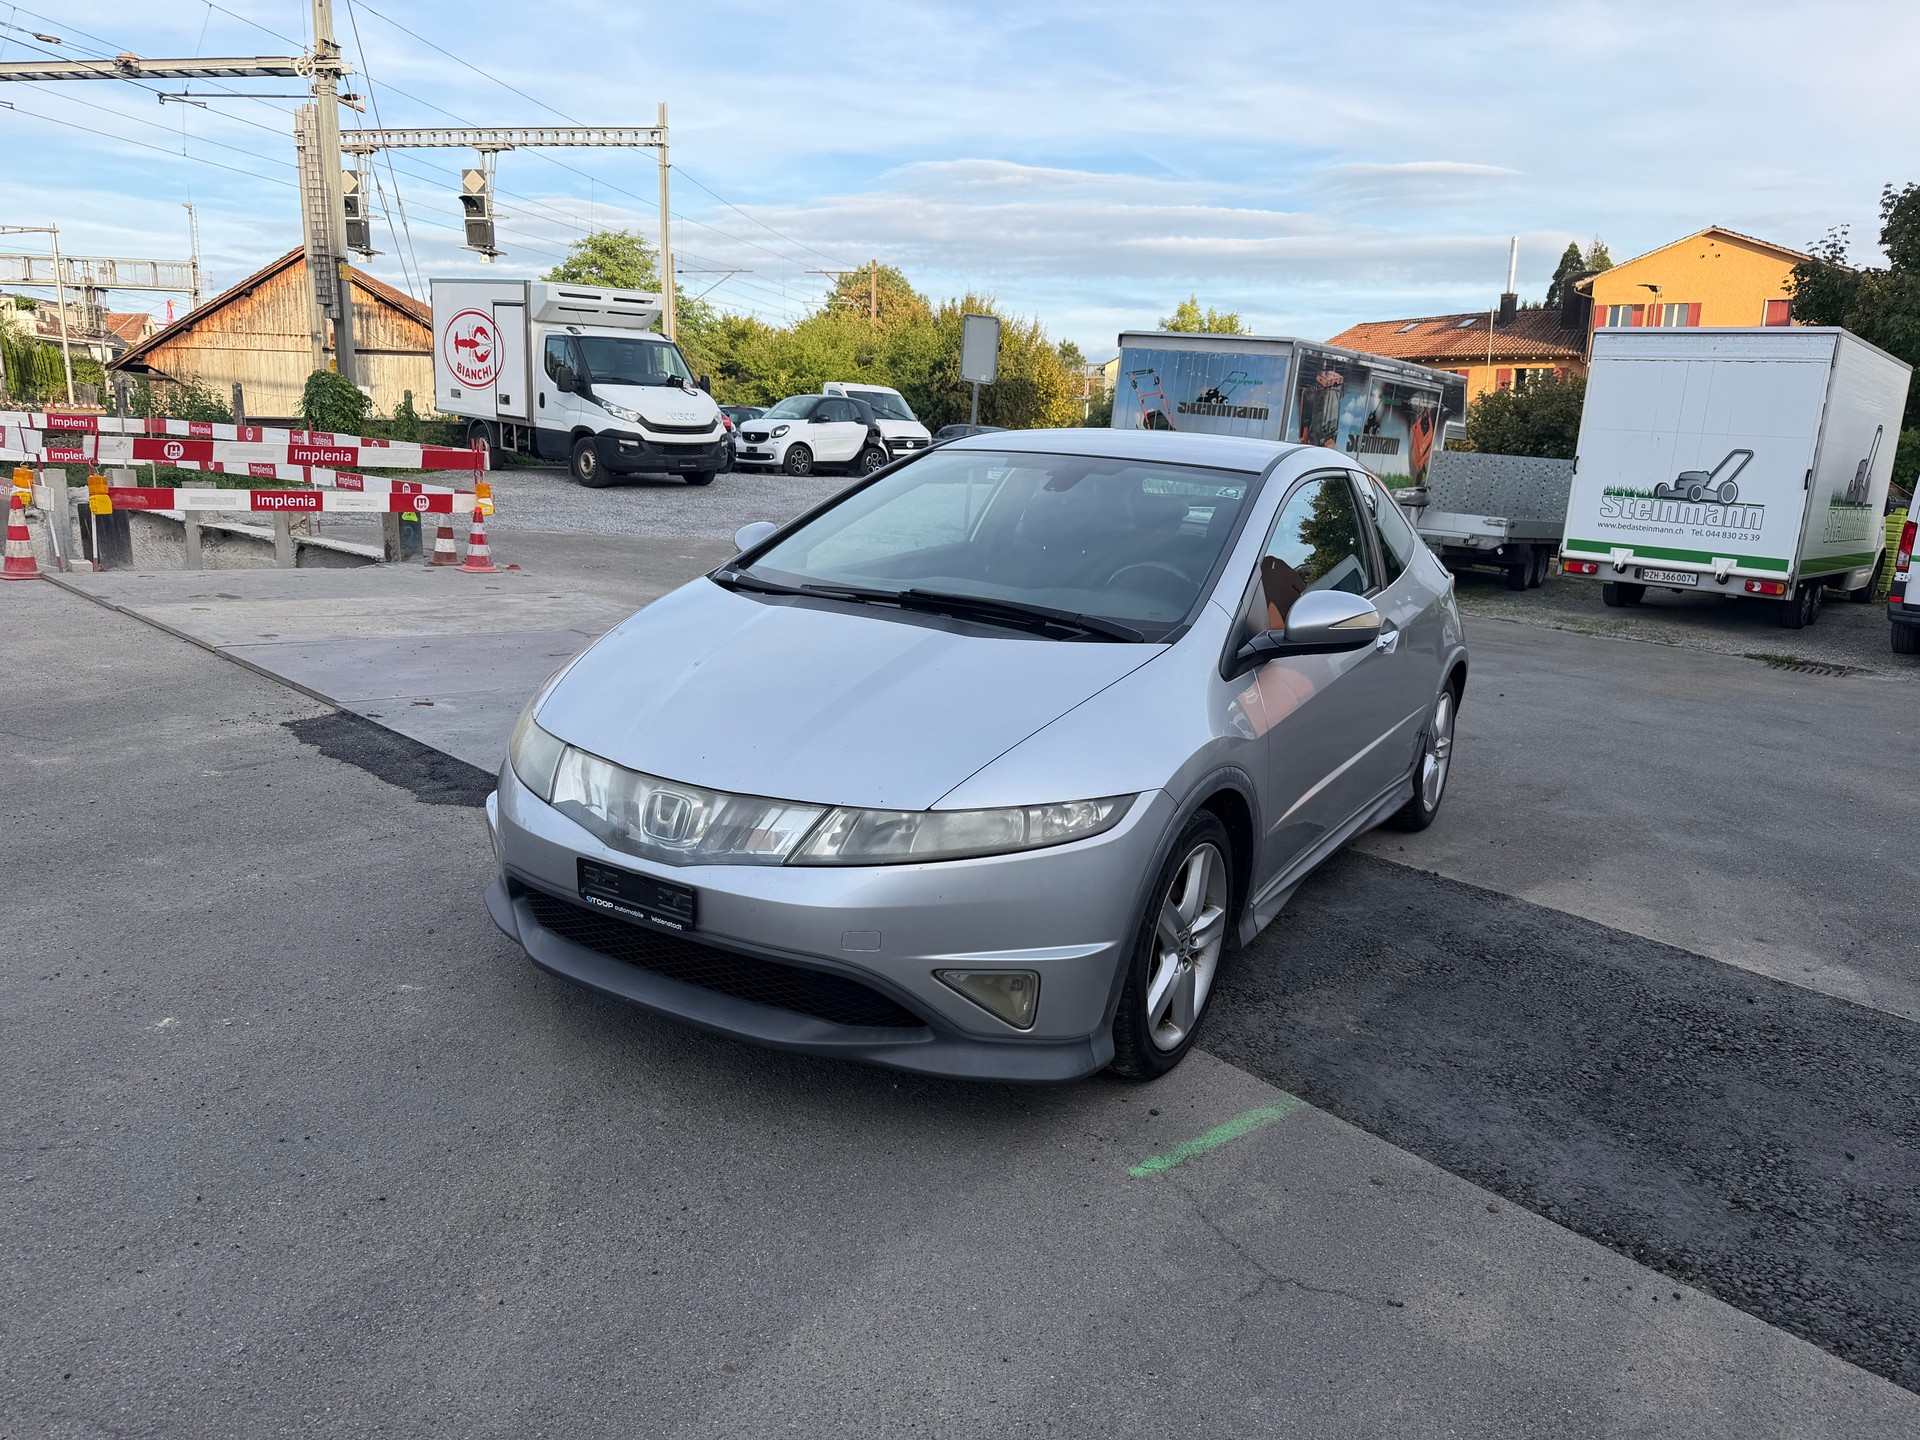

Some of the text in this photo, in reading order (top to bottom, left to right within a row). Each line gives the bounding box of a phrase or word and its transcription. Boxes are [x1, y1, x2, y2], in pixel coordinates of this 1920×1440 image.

[456, 361, 493, 380] BIANCHI
[51, 416, 94, 428] Impleni
[665, 412, 697, 421] IVECO
[190, 424, 211, 435] Implenia
[294, 449, 352, 463] Implenia
[250, 464, 274, 476] Implenia
[337, 474, 362, 488] Implenia
[257, 494, 316, 508] Implenia
[1600, 495, 1765, 531] Steinmann
[1597, 521, 1761, 542] www.bedasteinmann.ch Tel. 044 830 25 39
